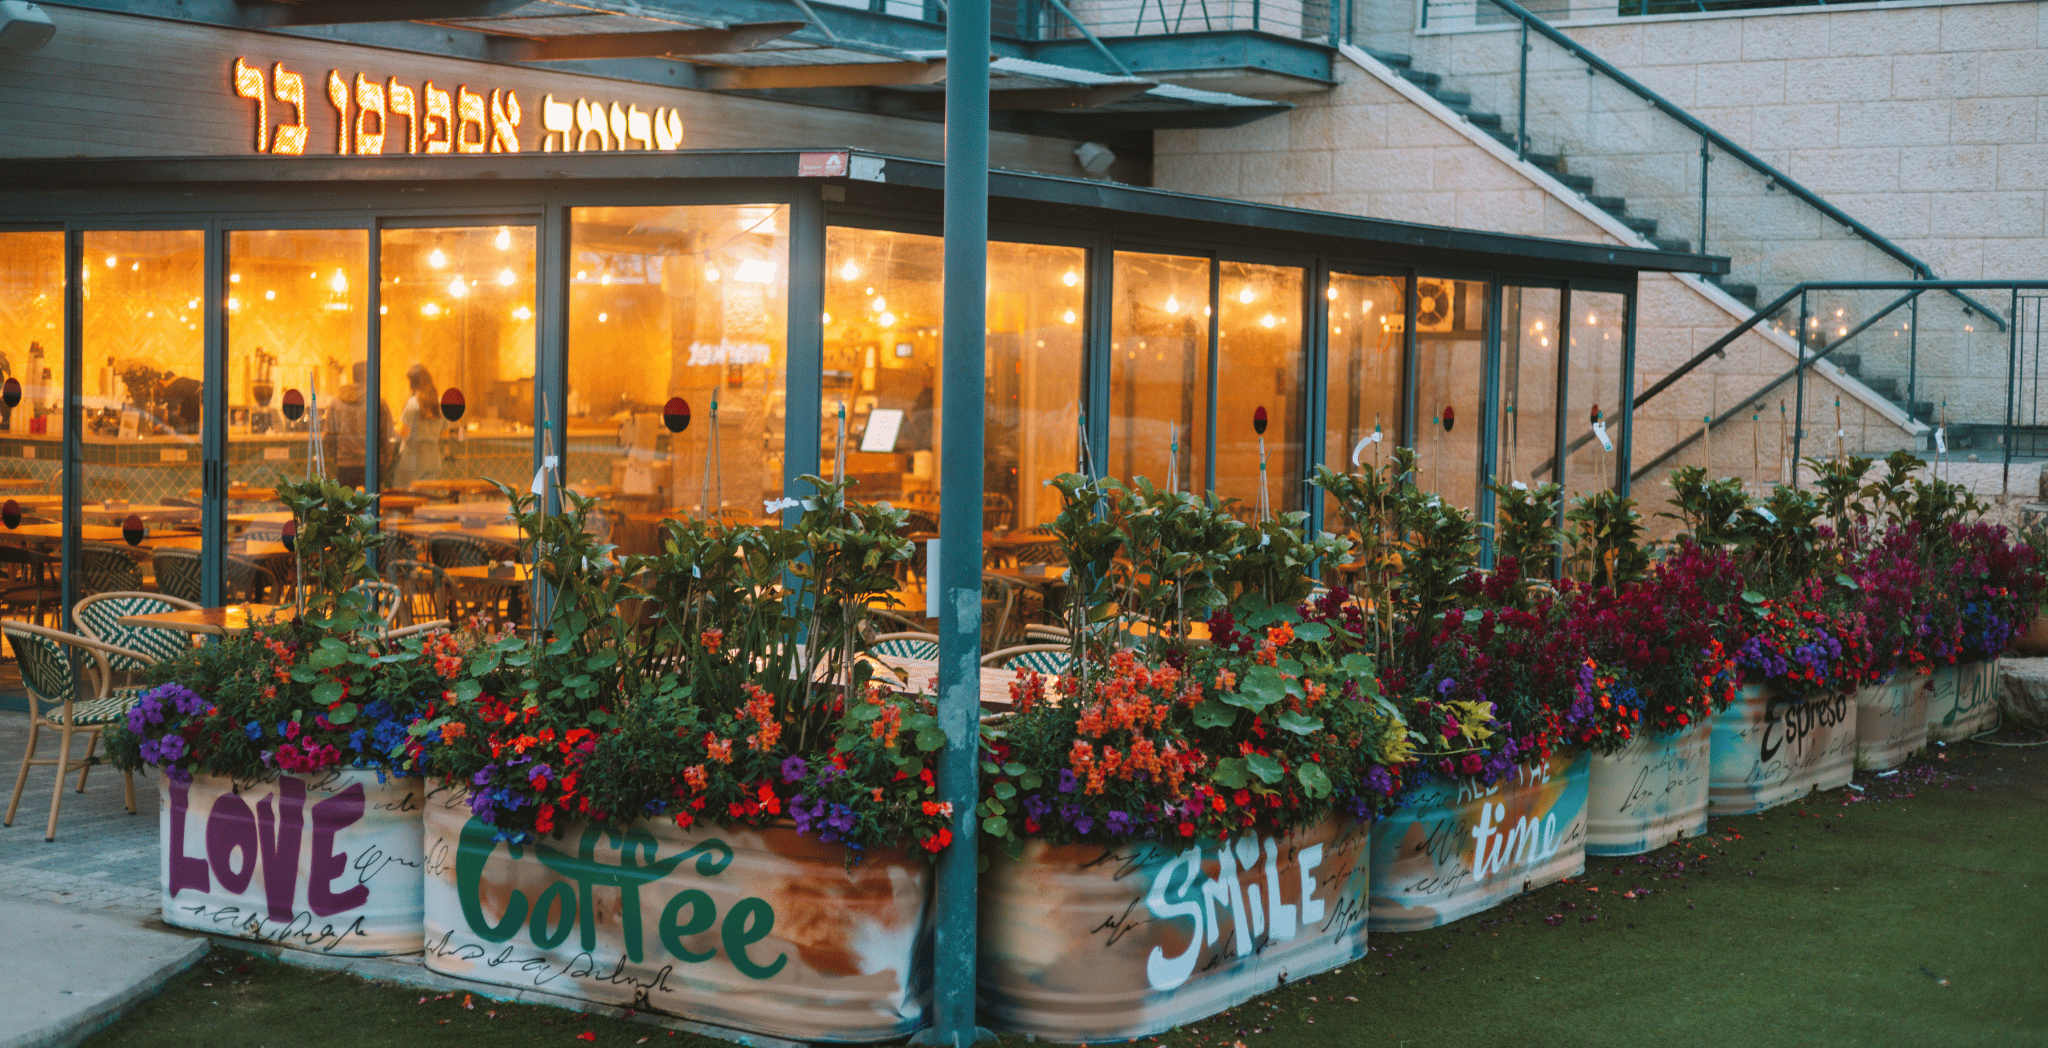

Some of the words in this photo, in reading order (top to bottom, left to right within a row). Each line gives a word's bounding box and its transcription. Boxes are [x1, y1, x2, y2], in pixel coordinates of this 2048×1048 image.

[234, 56, 309, 155] בר
[328, 69, 521, 155] אספרסו
[543, 93, 683, 152] ארומה
[1760, 693, 1847, 763] Espreso
[168, 769, 370, 924] LOVE
[1471, 801, 1563, 882] time
[456, 816, 787, 979] Coffee
